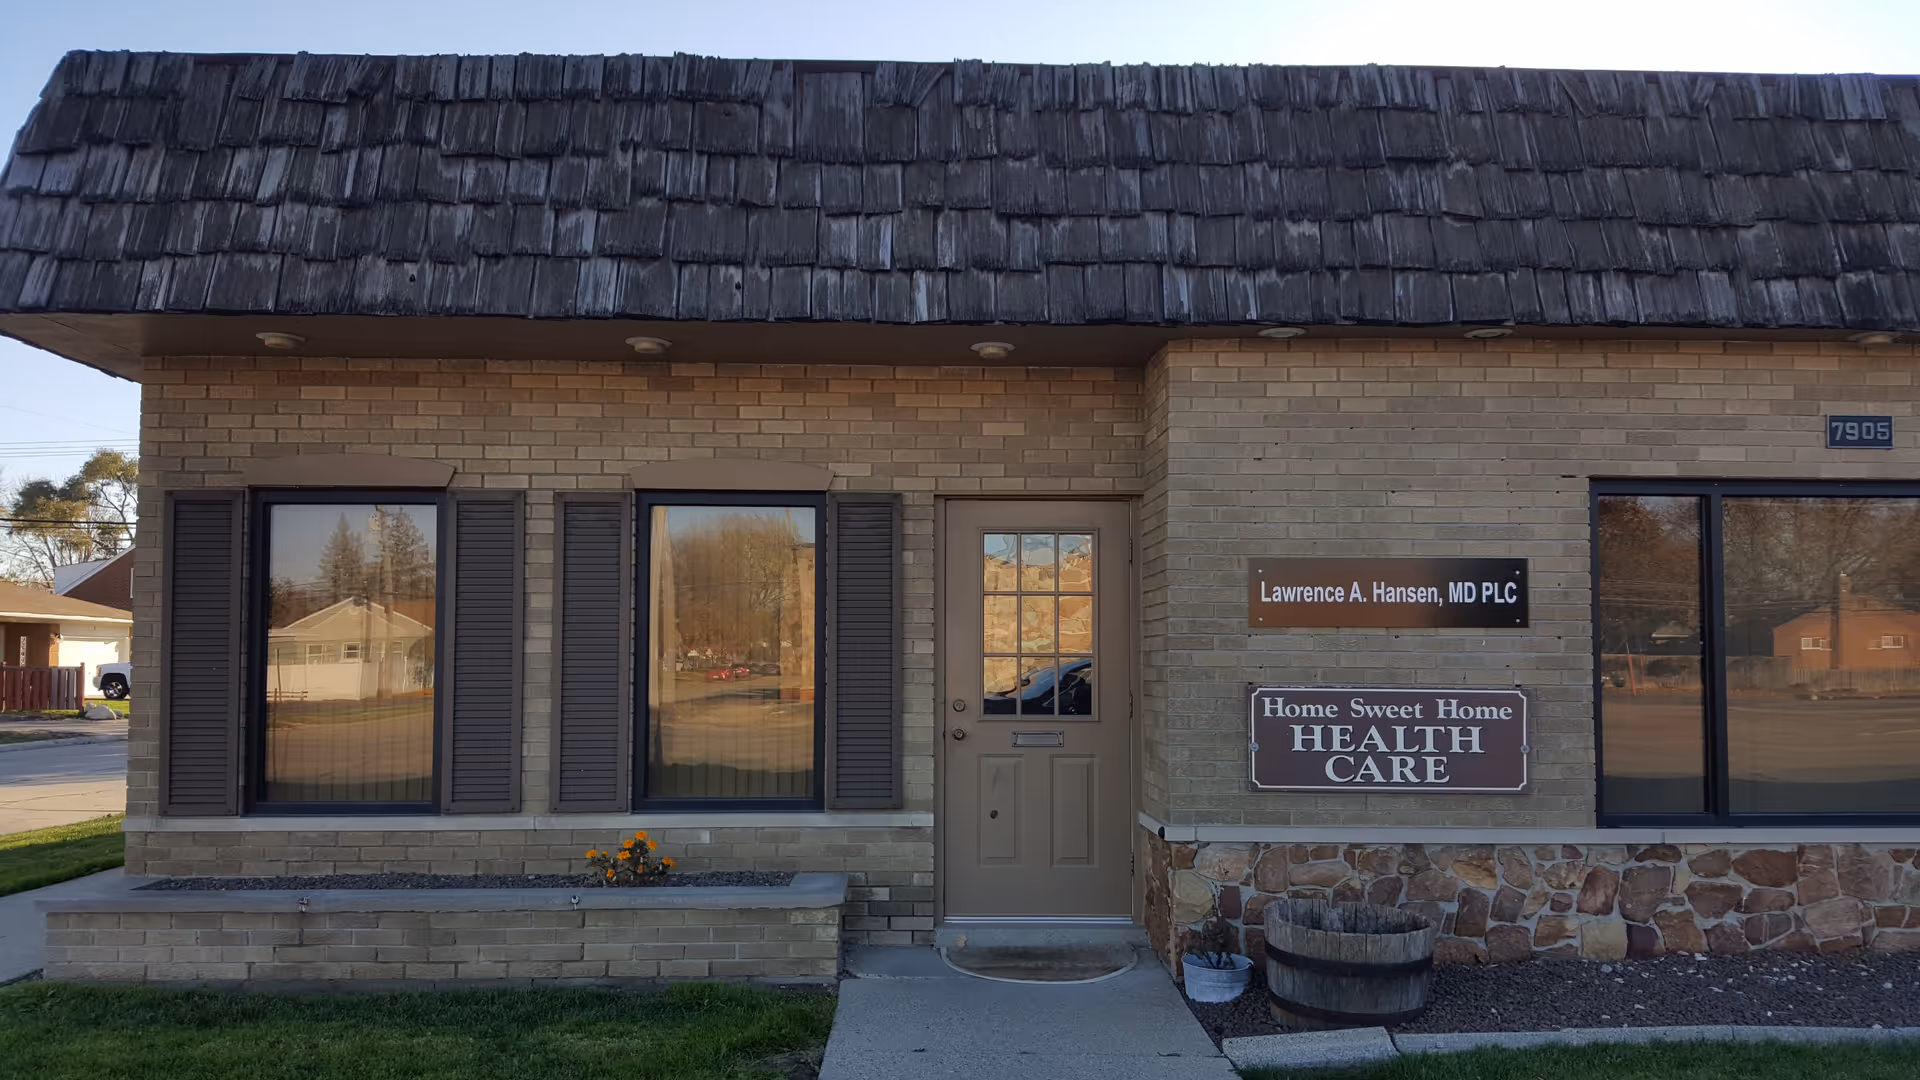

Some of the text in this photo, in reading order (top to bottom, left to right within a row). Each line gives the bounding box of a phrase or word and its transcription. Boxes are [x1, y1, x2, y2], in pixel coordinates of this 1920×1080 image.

[1831, 421, 1890, 441] 7905
[1260, 581, 1517, 607] Lawrence A. Hansen, MD PLC
[1262, 697, 1513, 720] Home Sweet Home
[1289, 724, 1485, 753] HEALTH
[1325, 755, 1450, 783] CARE
